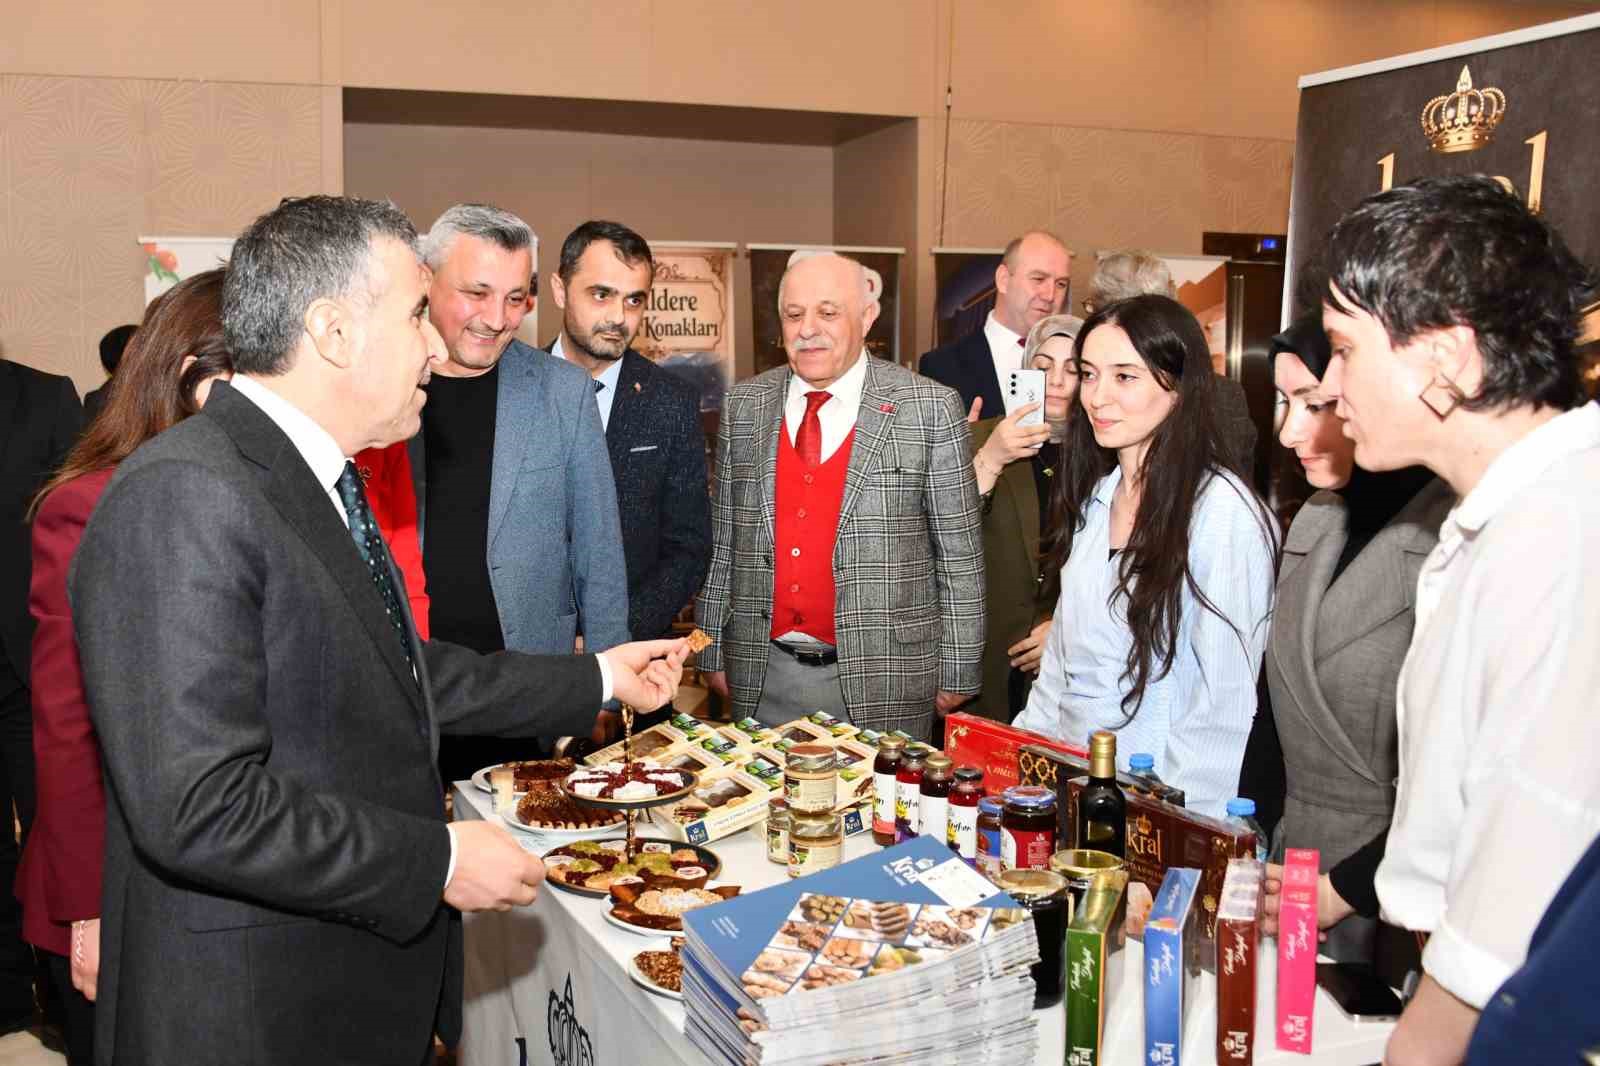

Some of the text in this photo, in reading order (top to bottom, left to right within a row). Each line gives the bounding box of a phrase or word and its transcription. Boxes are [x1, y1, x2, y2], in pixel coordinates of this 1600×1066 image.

[645, 288, 698, 312] ldere
[643, 316, 719, 342] Konakları
[1127, 823, 1162, 863] kral
[1287, 1013, 1309, 1043] kral
[1072, 1046, 1094, 1066] ral
[1227, 1030, 1249, 1060] kral
